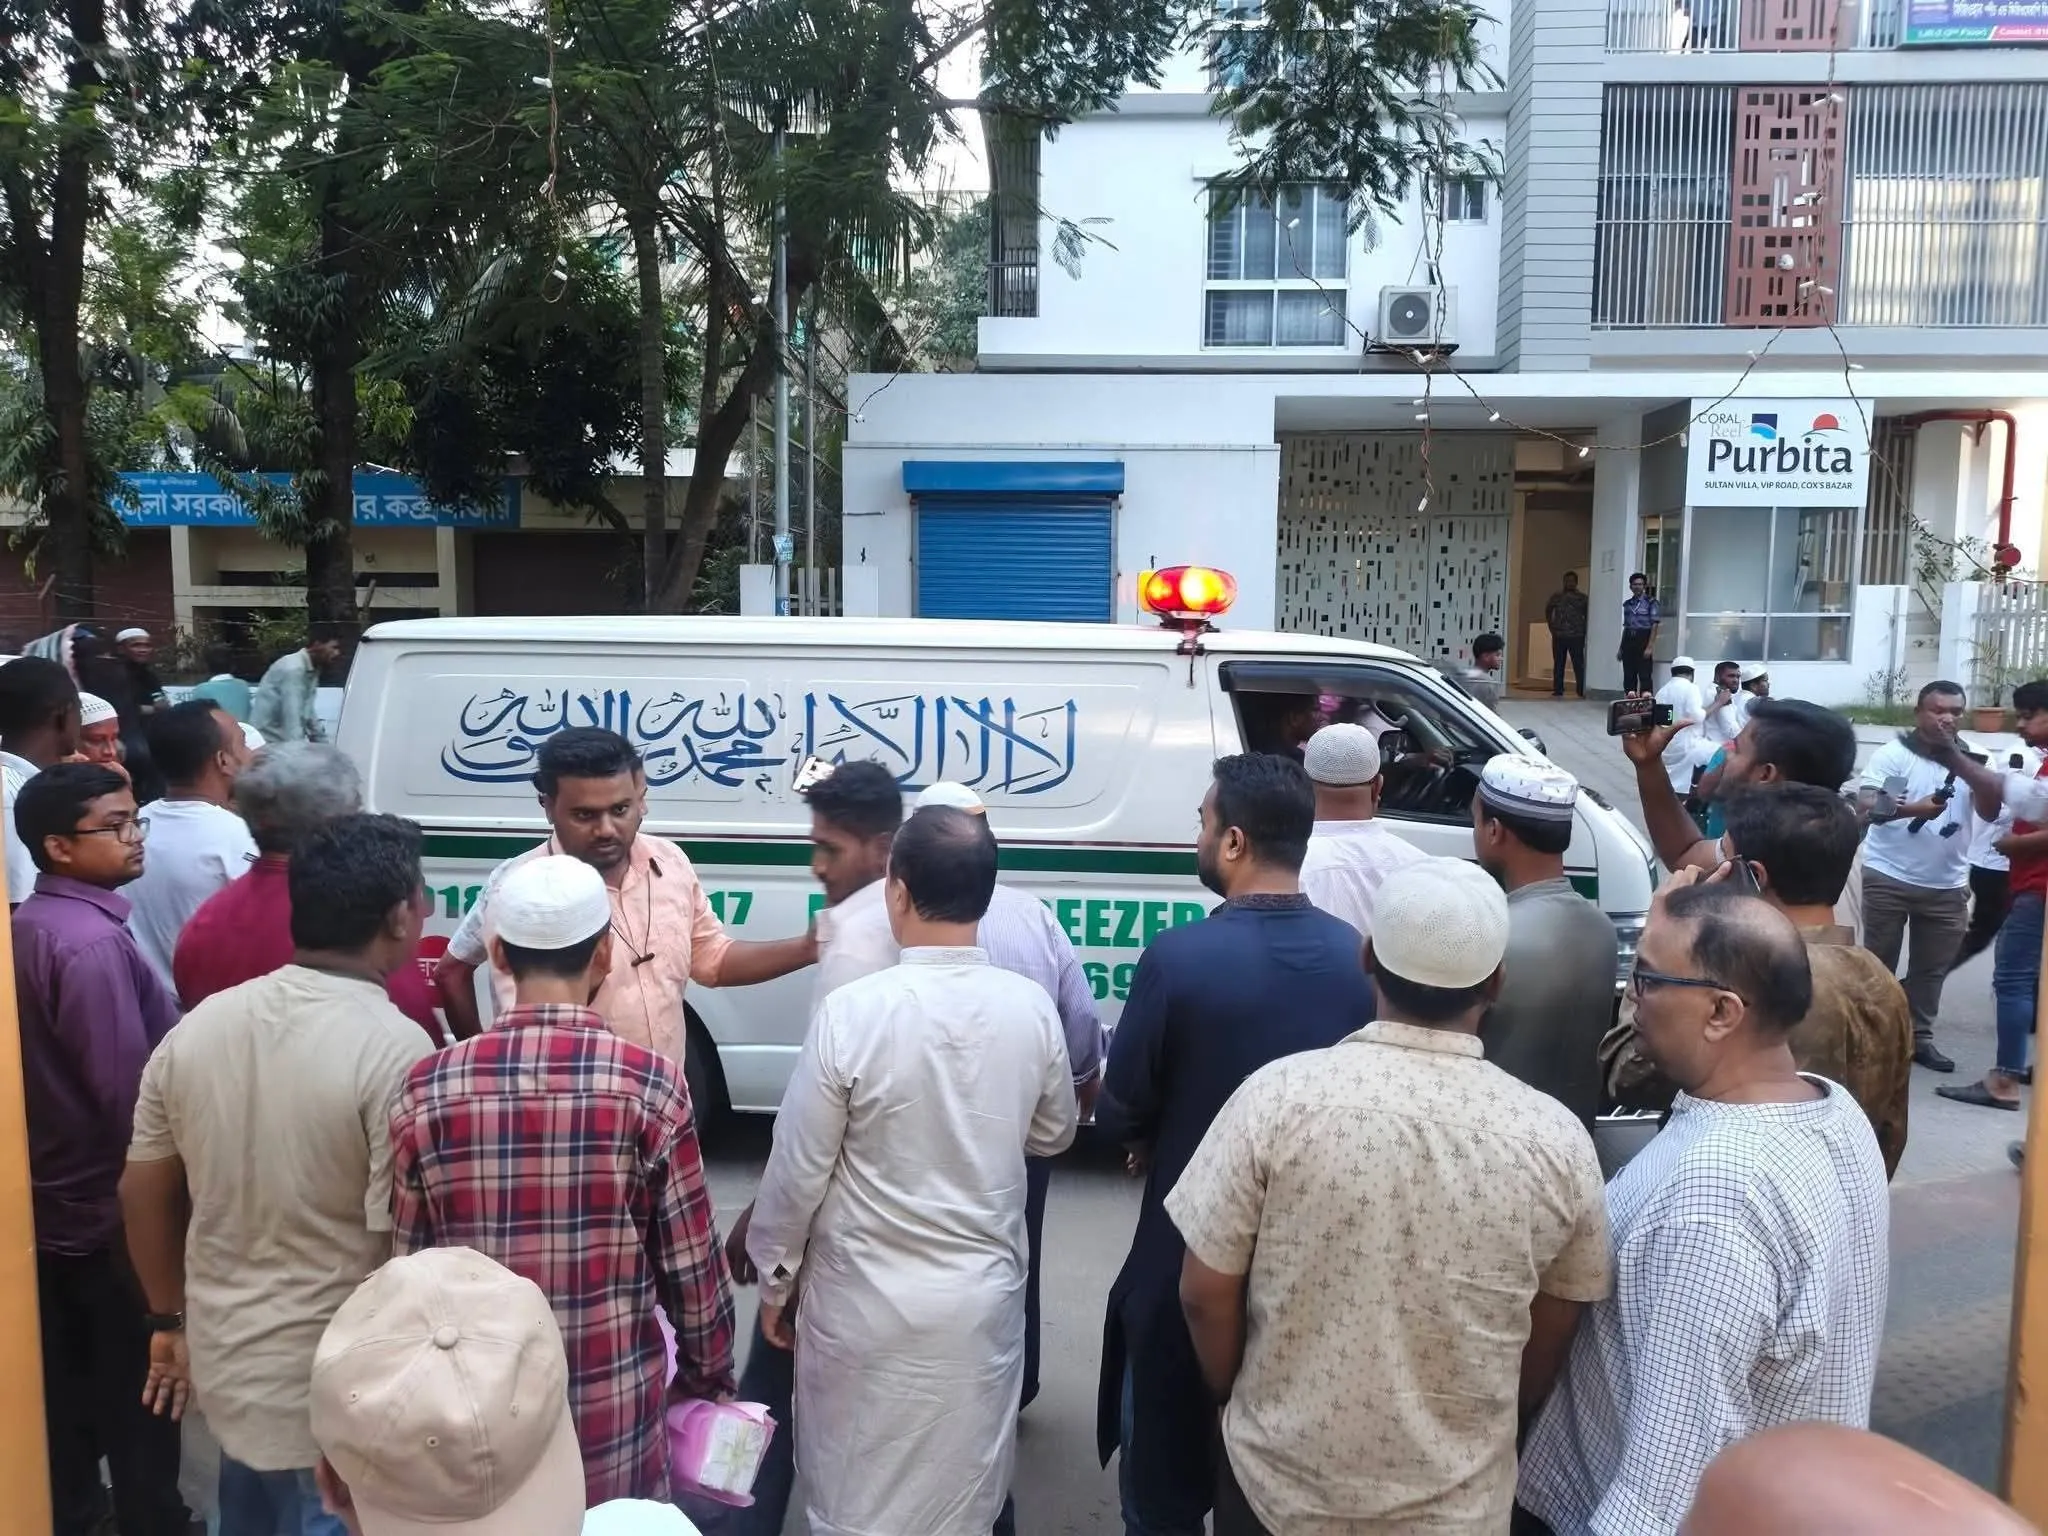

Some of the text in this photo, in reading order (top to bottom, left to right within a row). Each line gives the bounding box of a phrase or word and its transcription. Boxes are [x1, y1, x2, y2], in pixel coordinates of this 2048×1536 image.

[1698, 413, 1741, 424] CORAL
[1707, 436, 1854, 474] Purbita
[1703, 480, 1735, 490] SULTAN
[1734, 480, 1760, 491] VILLA,
[1760, 480, 1774, 490] VIP
[1825, 481, 1853, 490] BAZAR
